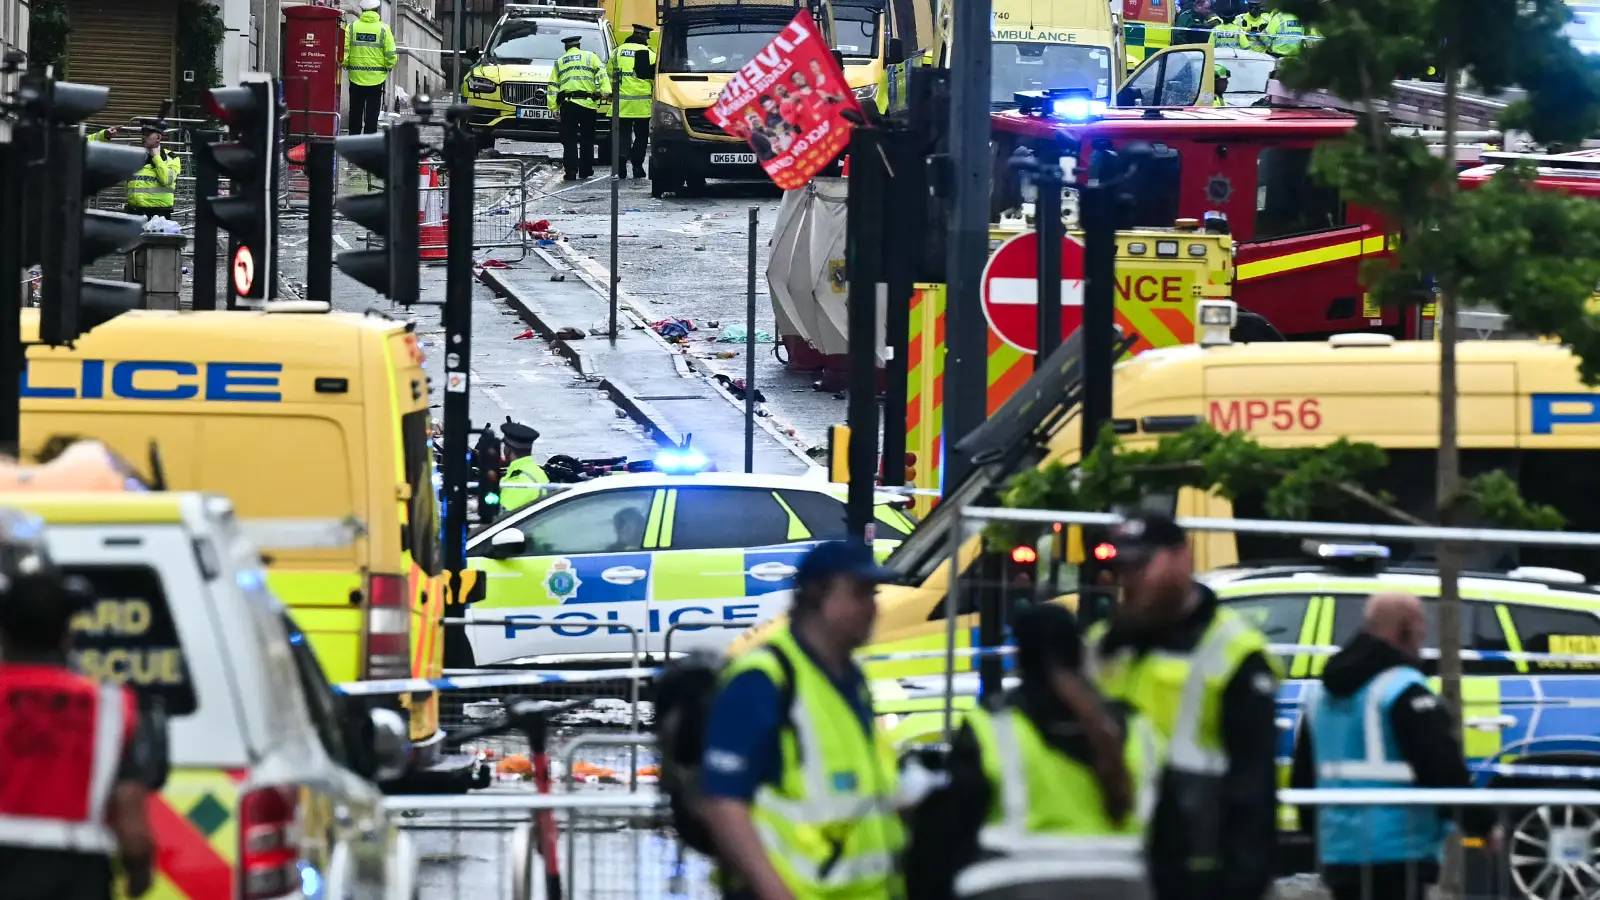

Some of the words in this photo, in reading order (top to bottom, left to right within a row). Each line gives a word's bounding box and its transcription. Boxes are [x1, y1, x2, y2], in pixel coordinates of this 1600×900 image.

[523, 109, 541, 118] AD16
[543, 109, 553, 118] FU
[714, 154, 736, 163] DK65
[20, 359, 283, 403] LICE
[1209, 398, 1322, 431] MP56
[503, 604, 760, 640] POLICE
